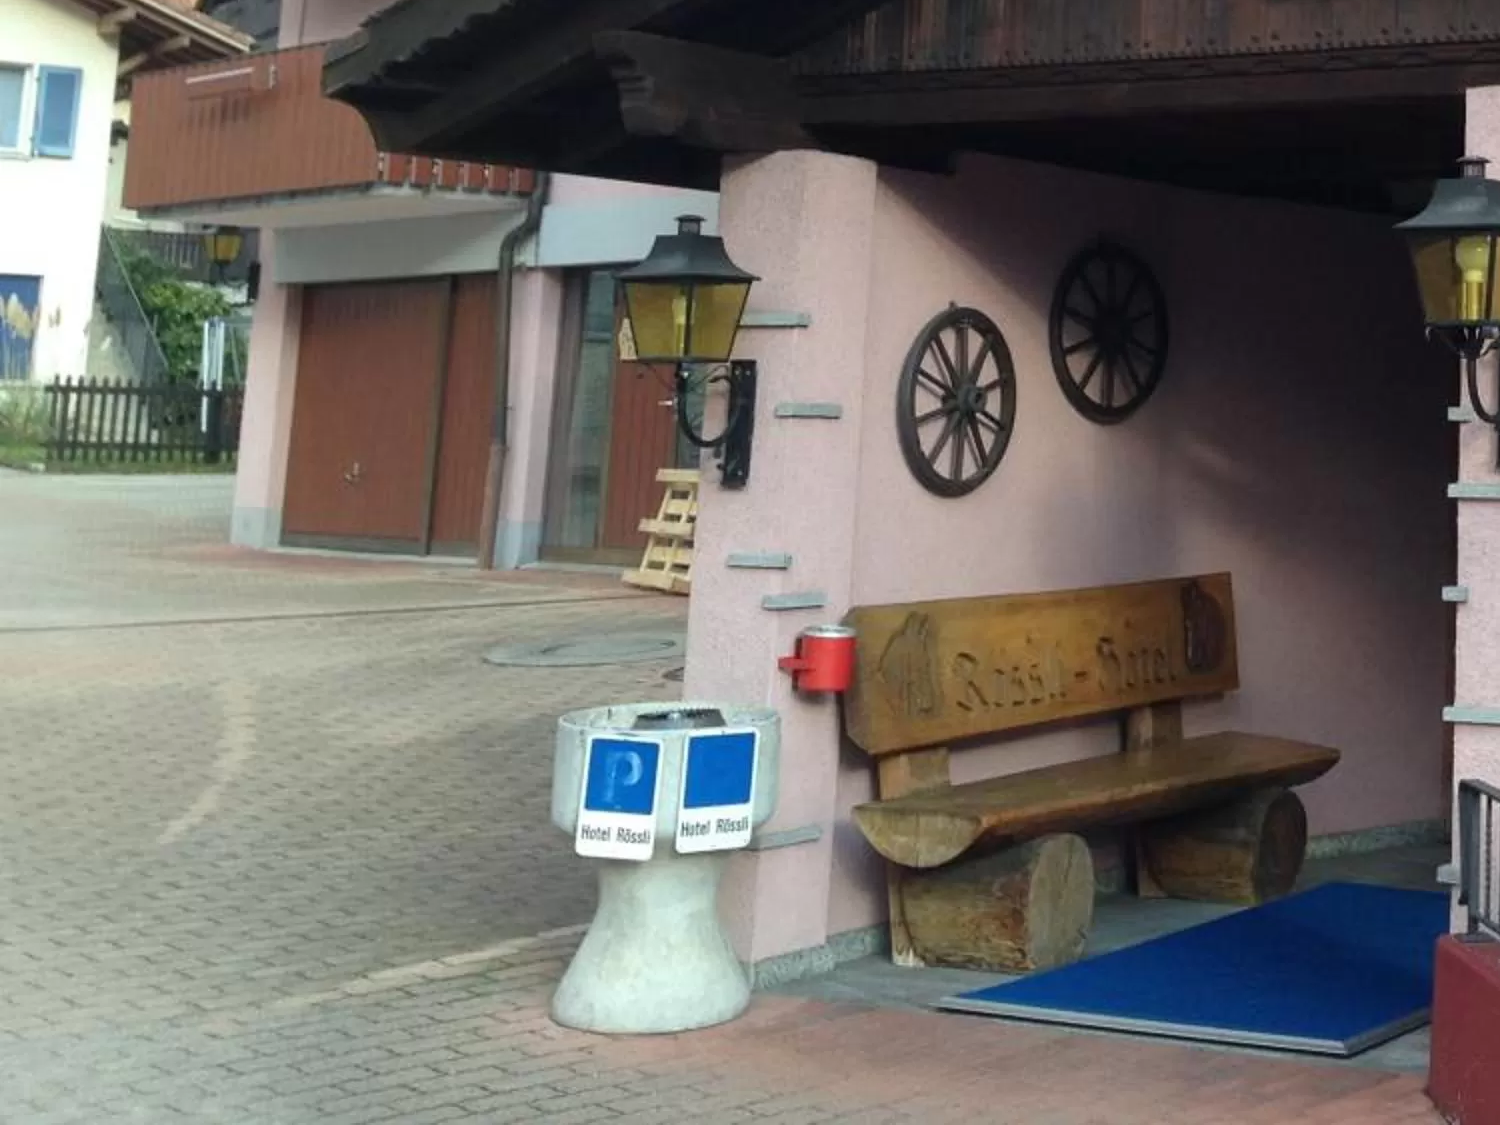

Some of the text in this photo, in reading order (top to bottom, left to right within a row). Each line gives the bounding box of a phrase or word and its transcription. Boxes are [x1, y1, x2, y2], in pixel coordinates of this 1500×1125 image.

[602, 750, 643, 804] P
[581, 824, 651, 844] Hotel Rössli
[681, 817, 749, 838] Hotel Rössli
